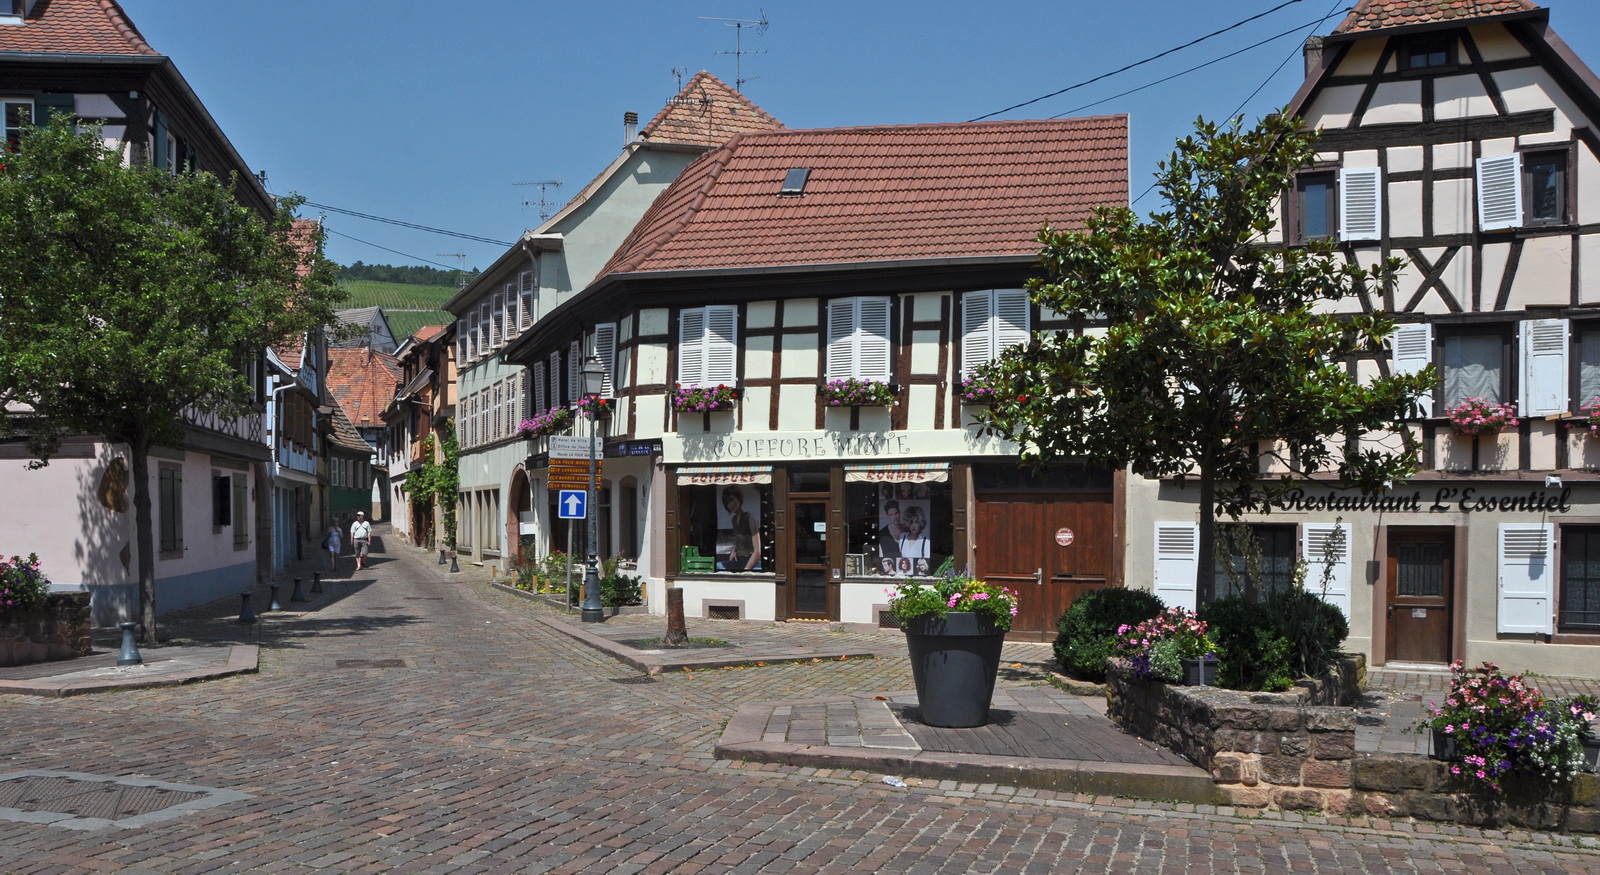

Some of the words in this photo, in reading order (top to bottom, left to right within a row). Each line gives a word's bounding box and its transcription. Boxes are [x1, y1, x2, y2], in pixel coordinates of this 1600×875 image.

[714, 437, 826, 458] COIFFURE
[837, 432, 910, 456] MIXTE
[691, 473, 756, 483] COIFFURE
[1281, 487, 1421, 513] Restaurant
[1429, 487, 1571, 513] L'Essentiel
